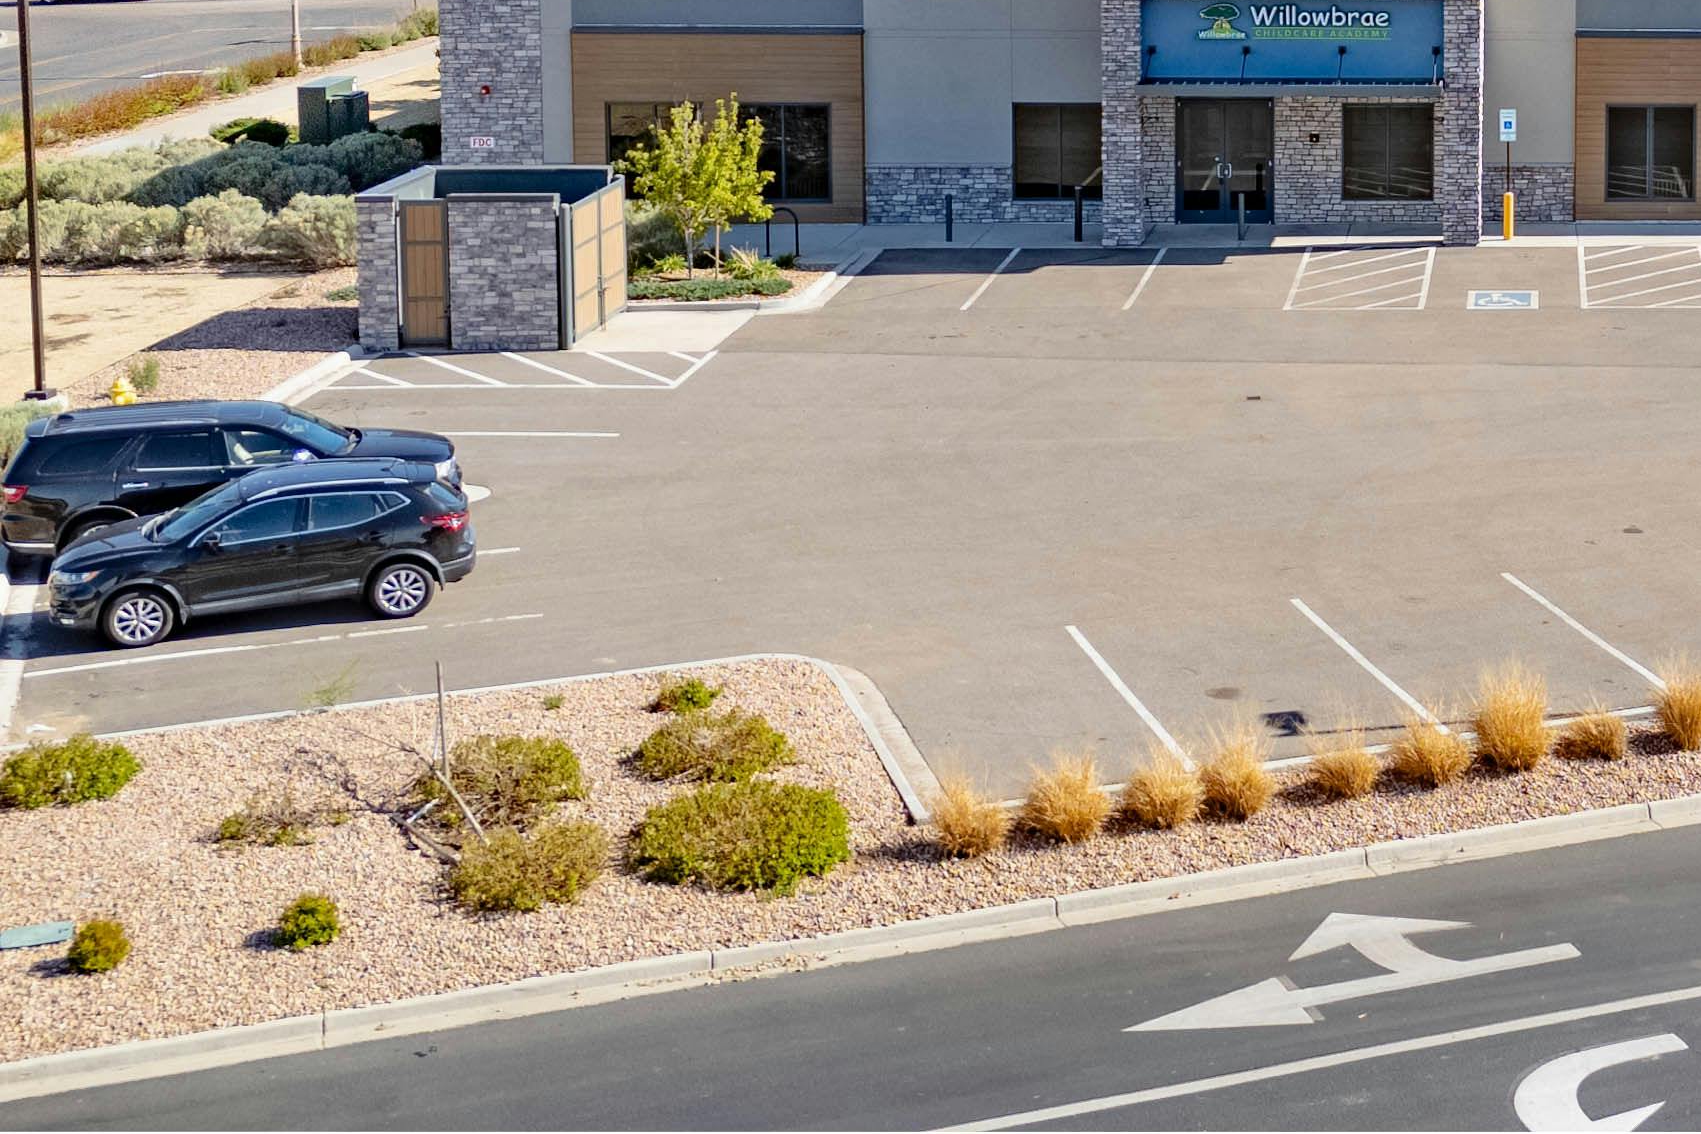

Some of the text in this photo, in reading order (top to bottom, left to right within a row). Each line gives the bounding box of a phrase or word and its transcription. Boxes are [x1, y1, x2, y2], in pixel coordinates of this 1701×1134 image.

[1250, 5, 1390, 27] Willowbrae
[1255, 29, 1388, 38] CHILDCARE ACADEMY
[473, 138, 492, 146] FDC
